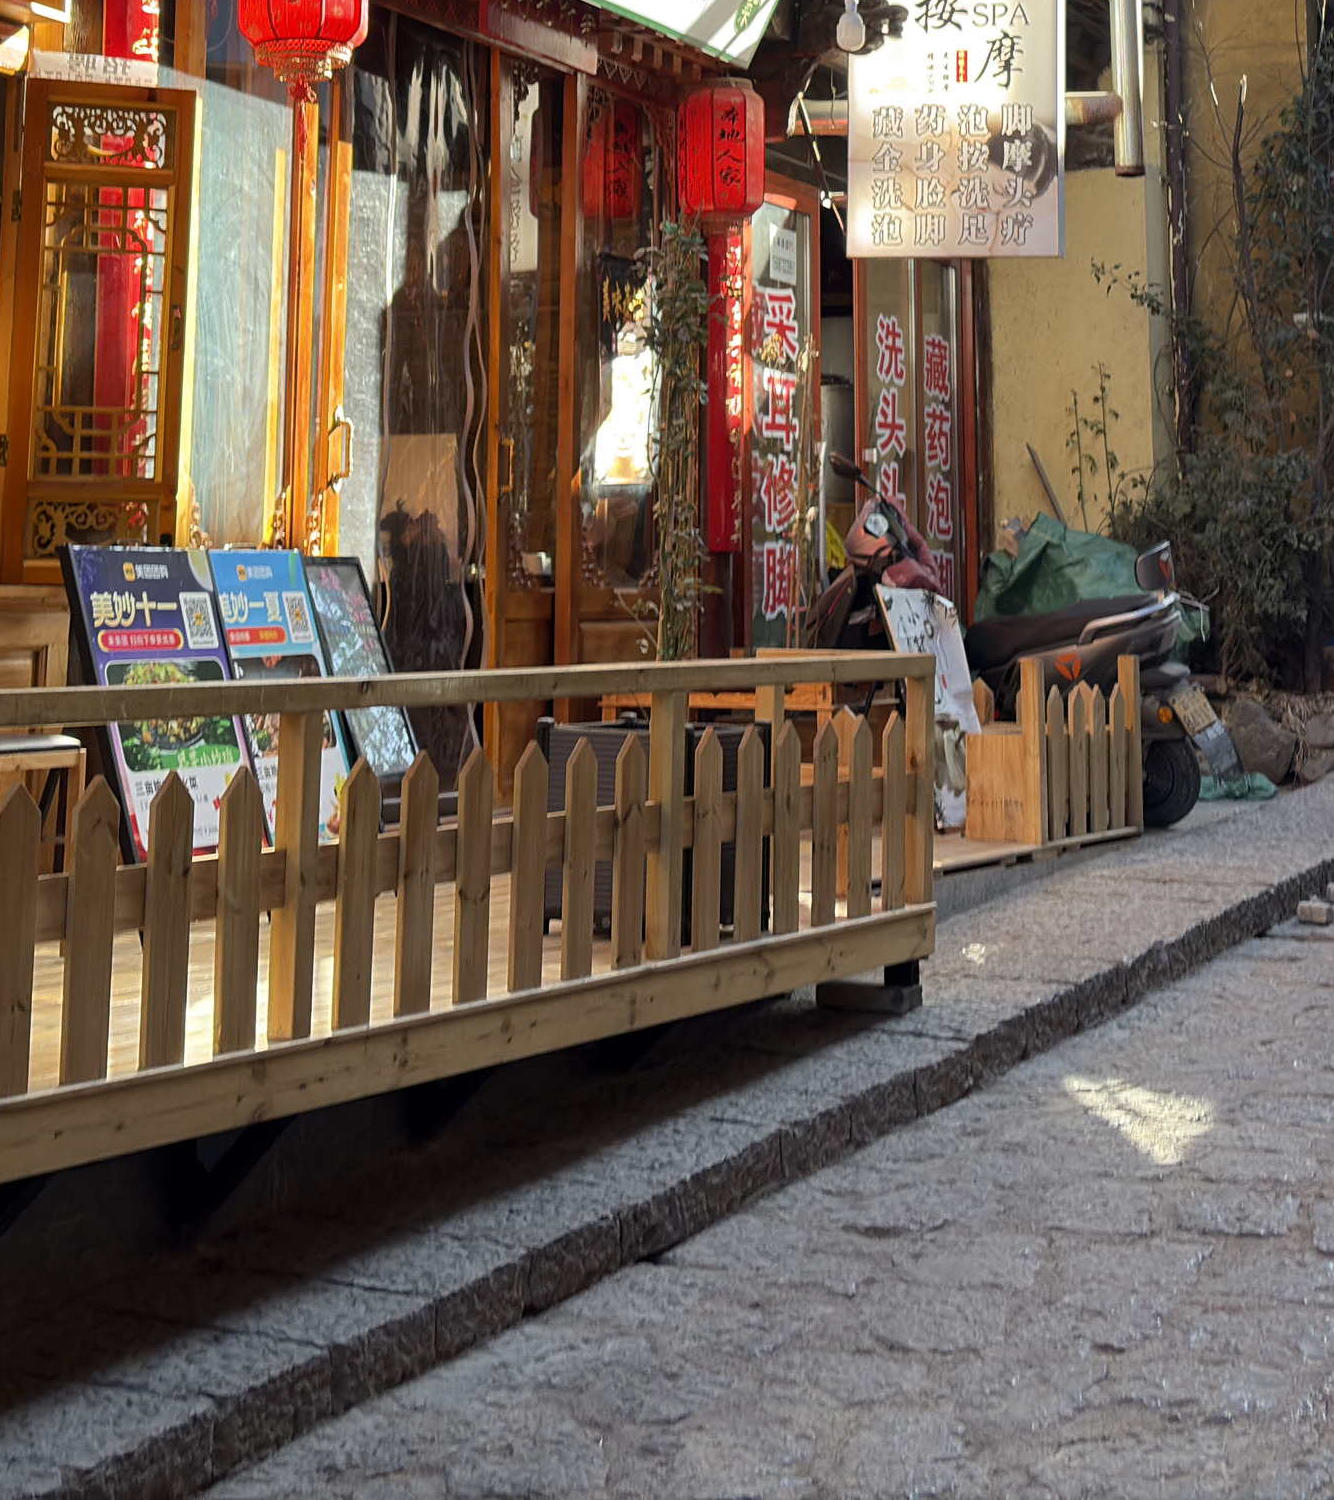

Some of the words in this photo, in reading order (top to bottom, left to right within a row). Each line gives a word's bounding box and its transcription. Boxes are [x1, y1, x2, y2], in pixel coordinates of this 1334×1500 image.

[972, 2, 1030, 28] SPA
[872, 103, 1034, 139] 藏药泡脚
[717, 106, 744, 187] 本地人家
[872, 141, 1034, 175] 全身按摩
[871, 176, 1034, 211] 洗脸洗头
[871, 213, 1034, 248] 泡脚足疗
[764, 288, 800, 620] 采耳修脚
[135, 563, 169, 580] 美团团购
[90, 590, 178, 628] 美妙十一
